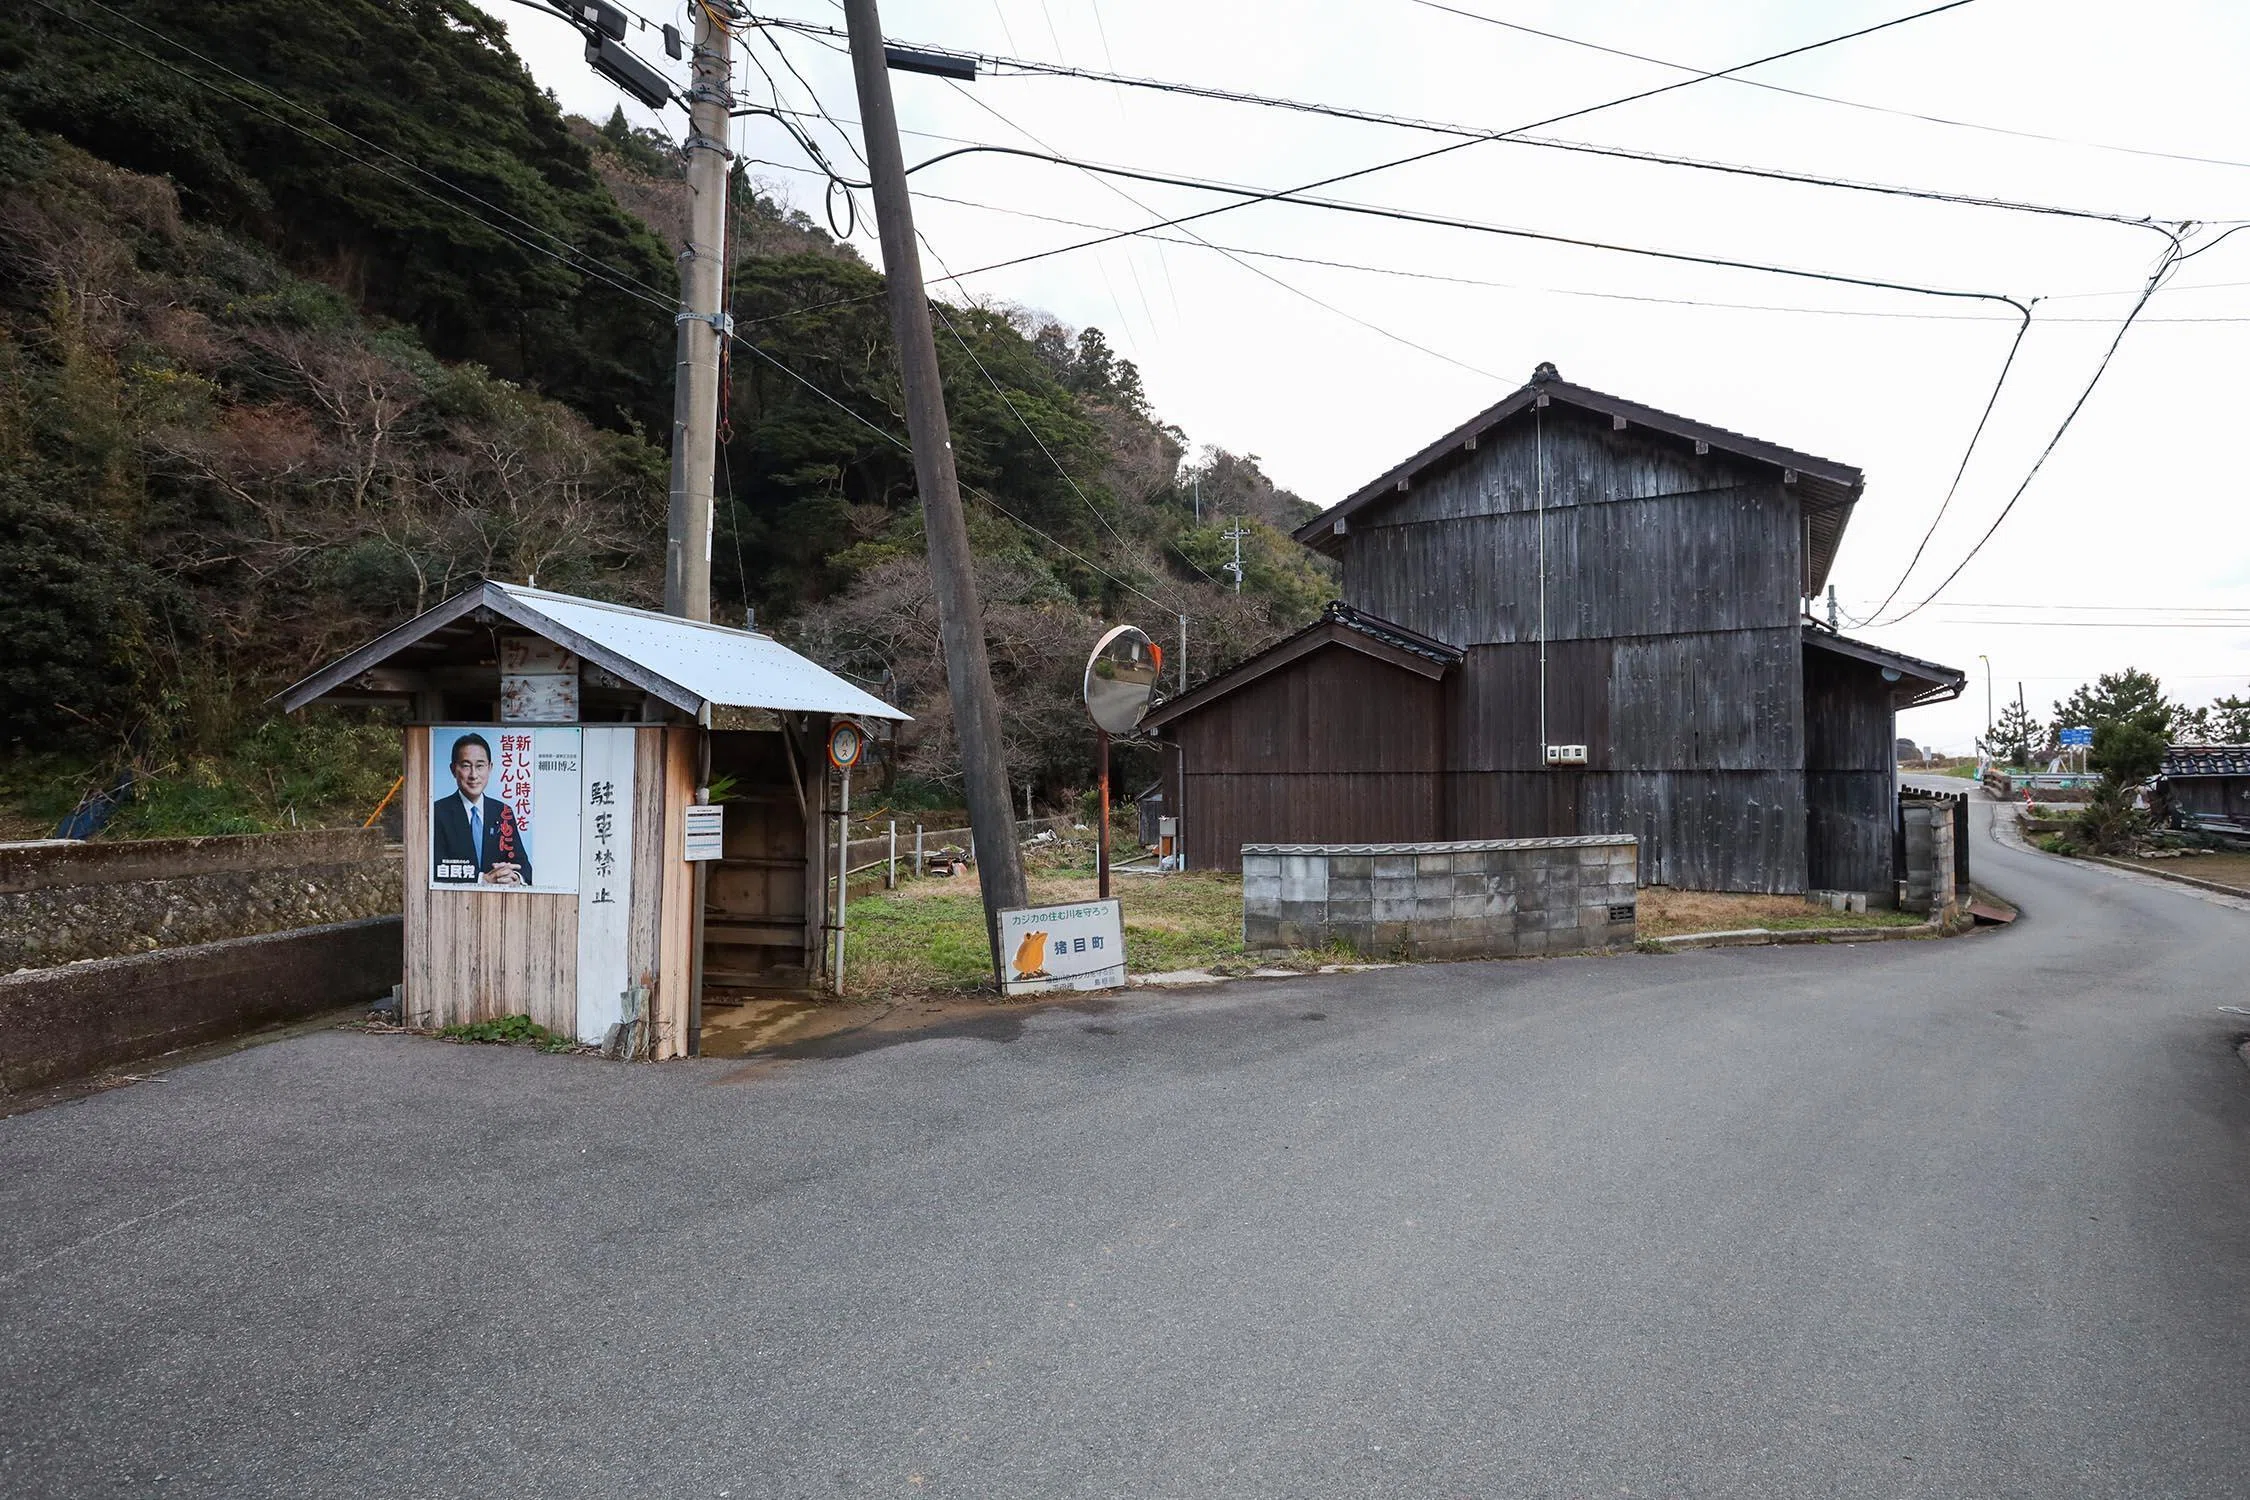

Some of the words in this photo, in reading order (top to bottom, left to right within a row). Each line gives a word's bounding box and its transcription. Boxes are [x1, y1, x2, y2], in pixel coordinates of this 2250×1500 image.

[538, 760, 577, 772] 細田博之
[515, 735, 531, 832] 新しい時代を
[590, 781, 616, 904] 駐車禁止
[437, 864, 475, 879] 自民党
[1012, 906, 1109, 926] カジカの住む川を守ろう
[1054, 936, 1105, 955] 猪目町
